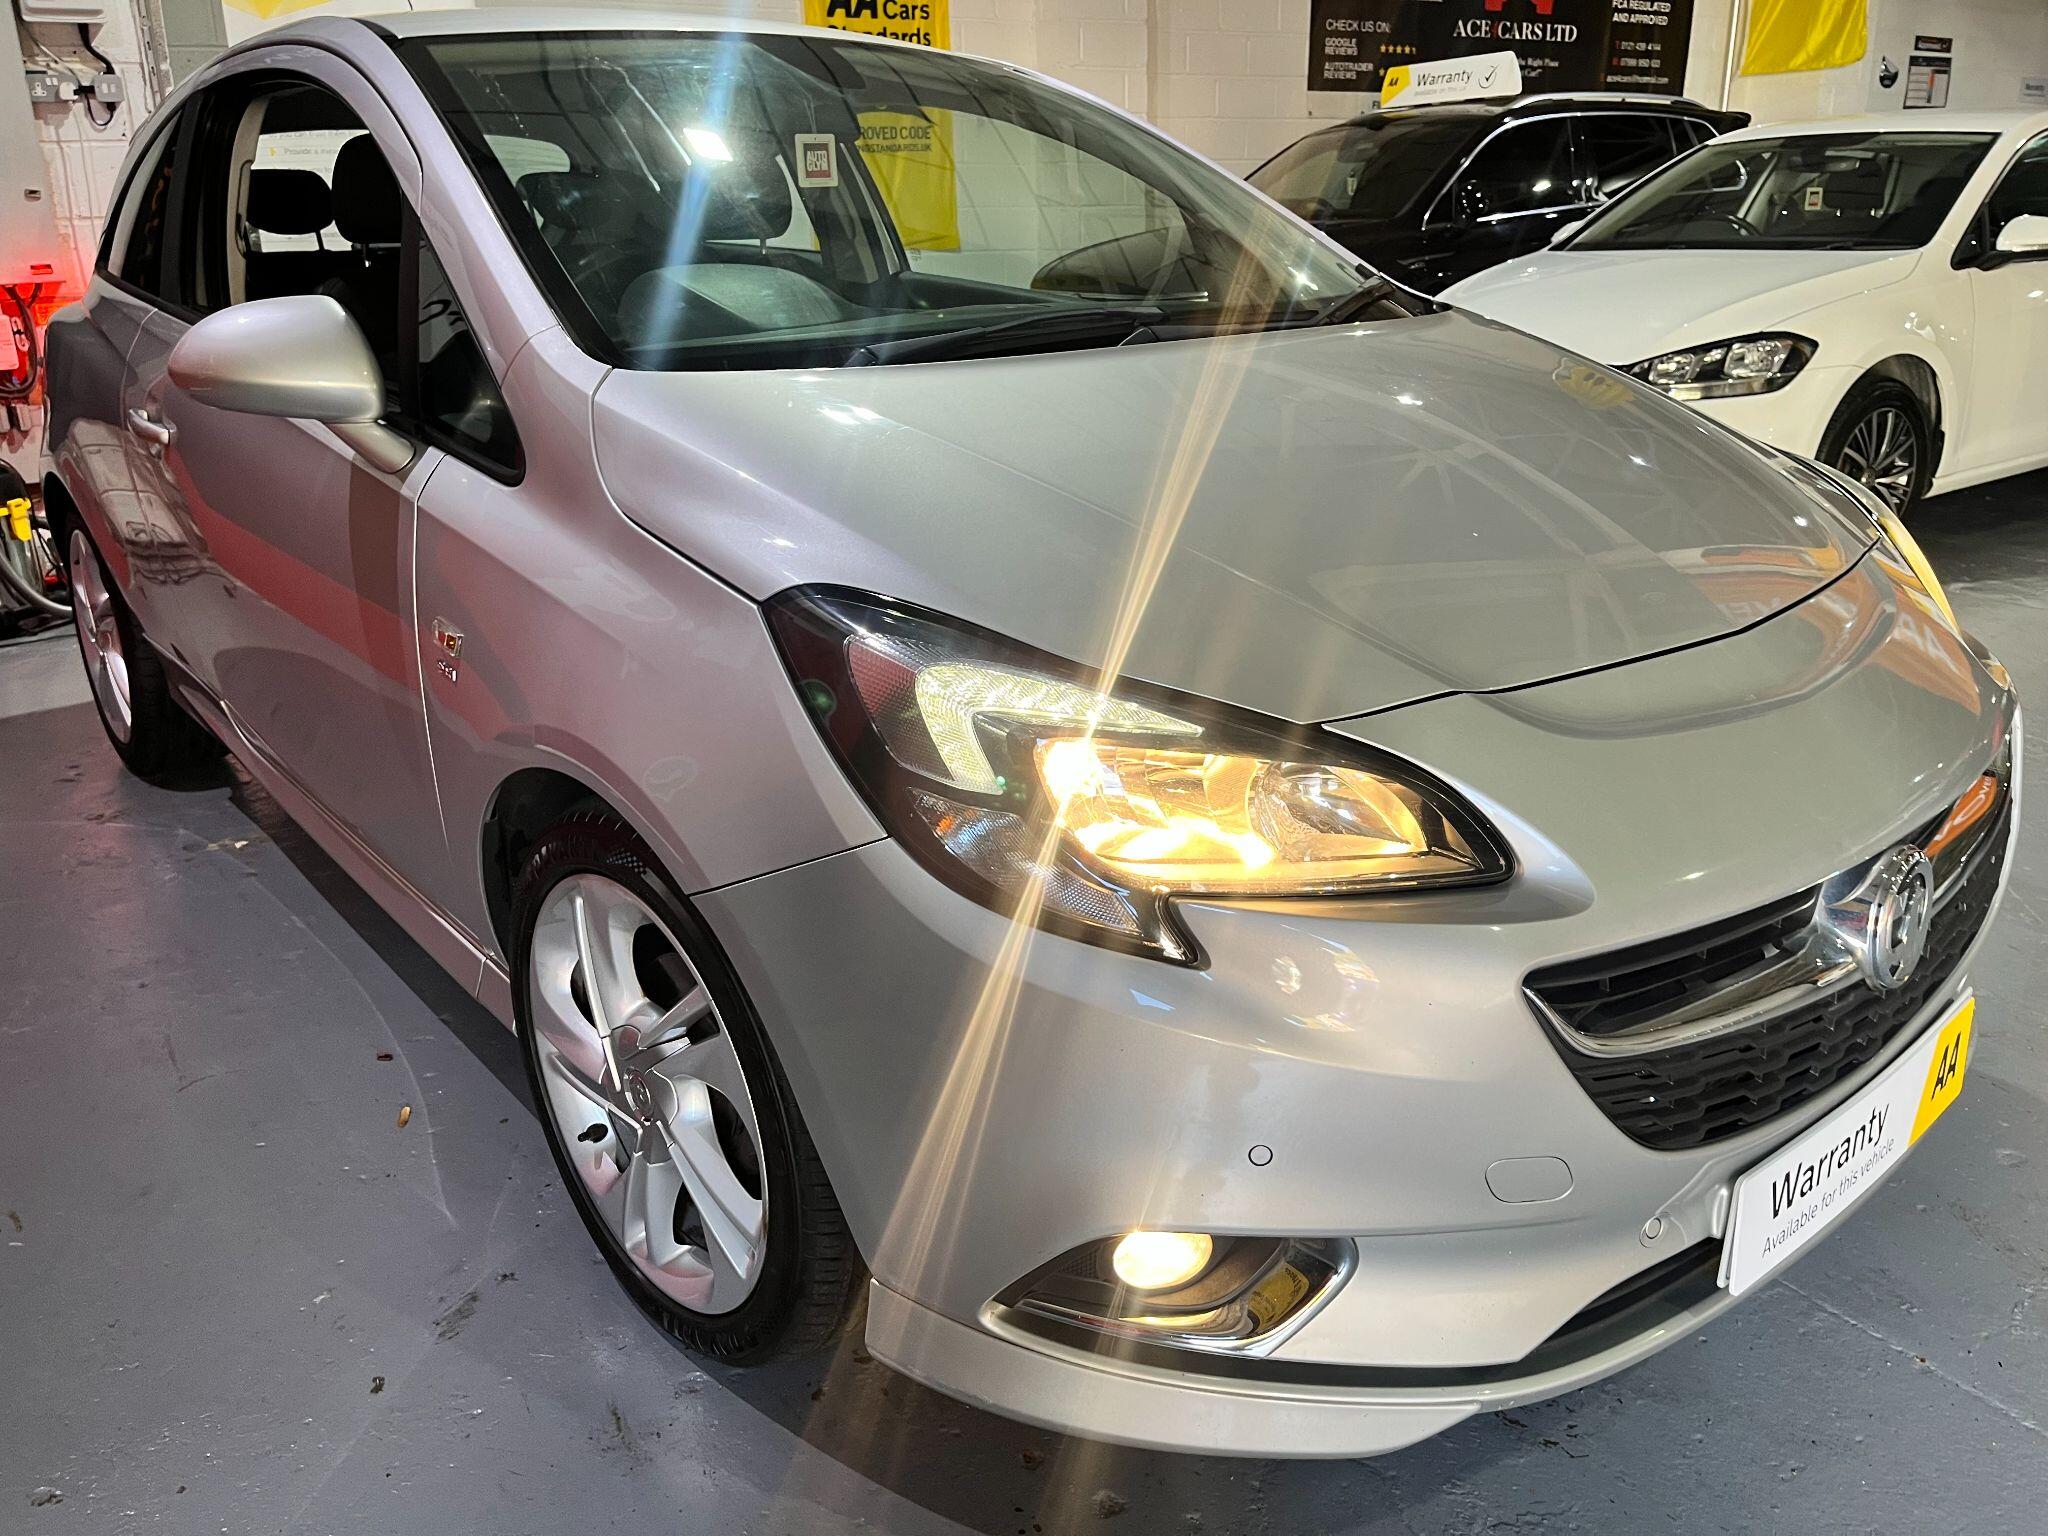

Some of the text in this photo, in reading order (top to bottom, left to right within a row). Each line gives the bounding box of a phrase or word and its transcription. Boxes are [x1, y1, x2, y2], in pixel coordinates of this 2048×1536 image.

[882, 0, 930, 20] Cars
[1325, 18, 1359, 31] CHECK
[1361, 21, 1375, 32] US
[1546, 23, 1578, 42] LTD
[828, 25, 931, 46] dards
[1417, 69, 1473, 87] Warranty
[899, 126, 931, 140] CODE
[806, 150, 828, 161] AUTO
[1931, 1031, 1961, 1101] AA
[1771, 1103, 1890, 1219] Warranty
[1762, 1136, 1894, 1258] Available for this vehicle
